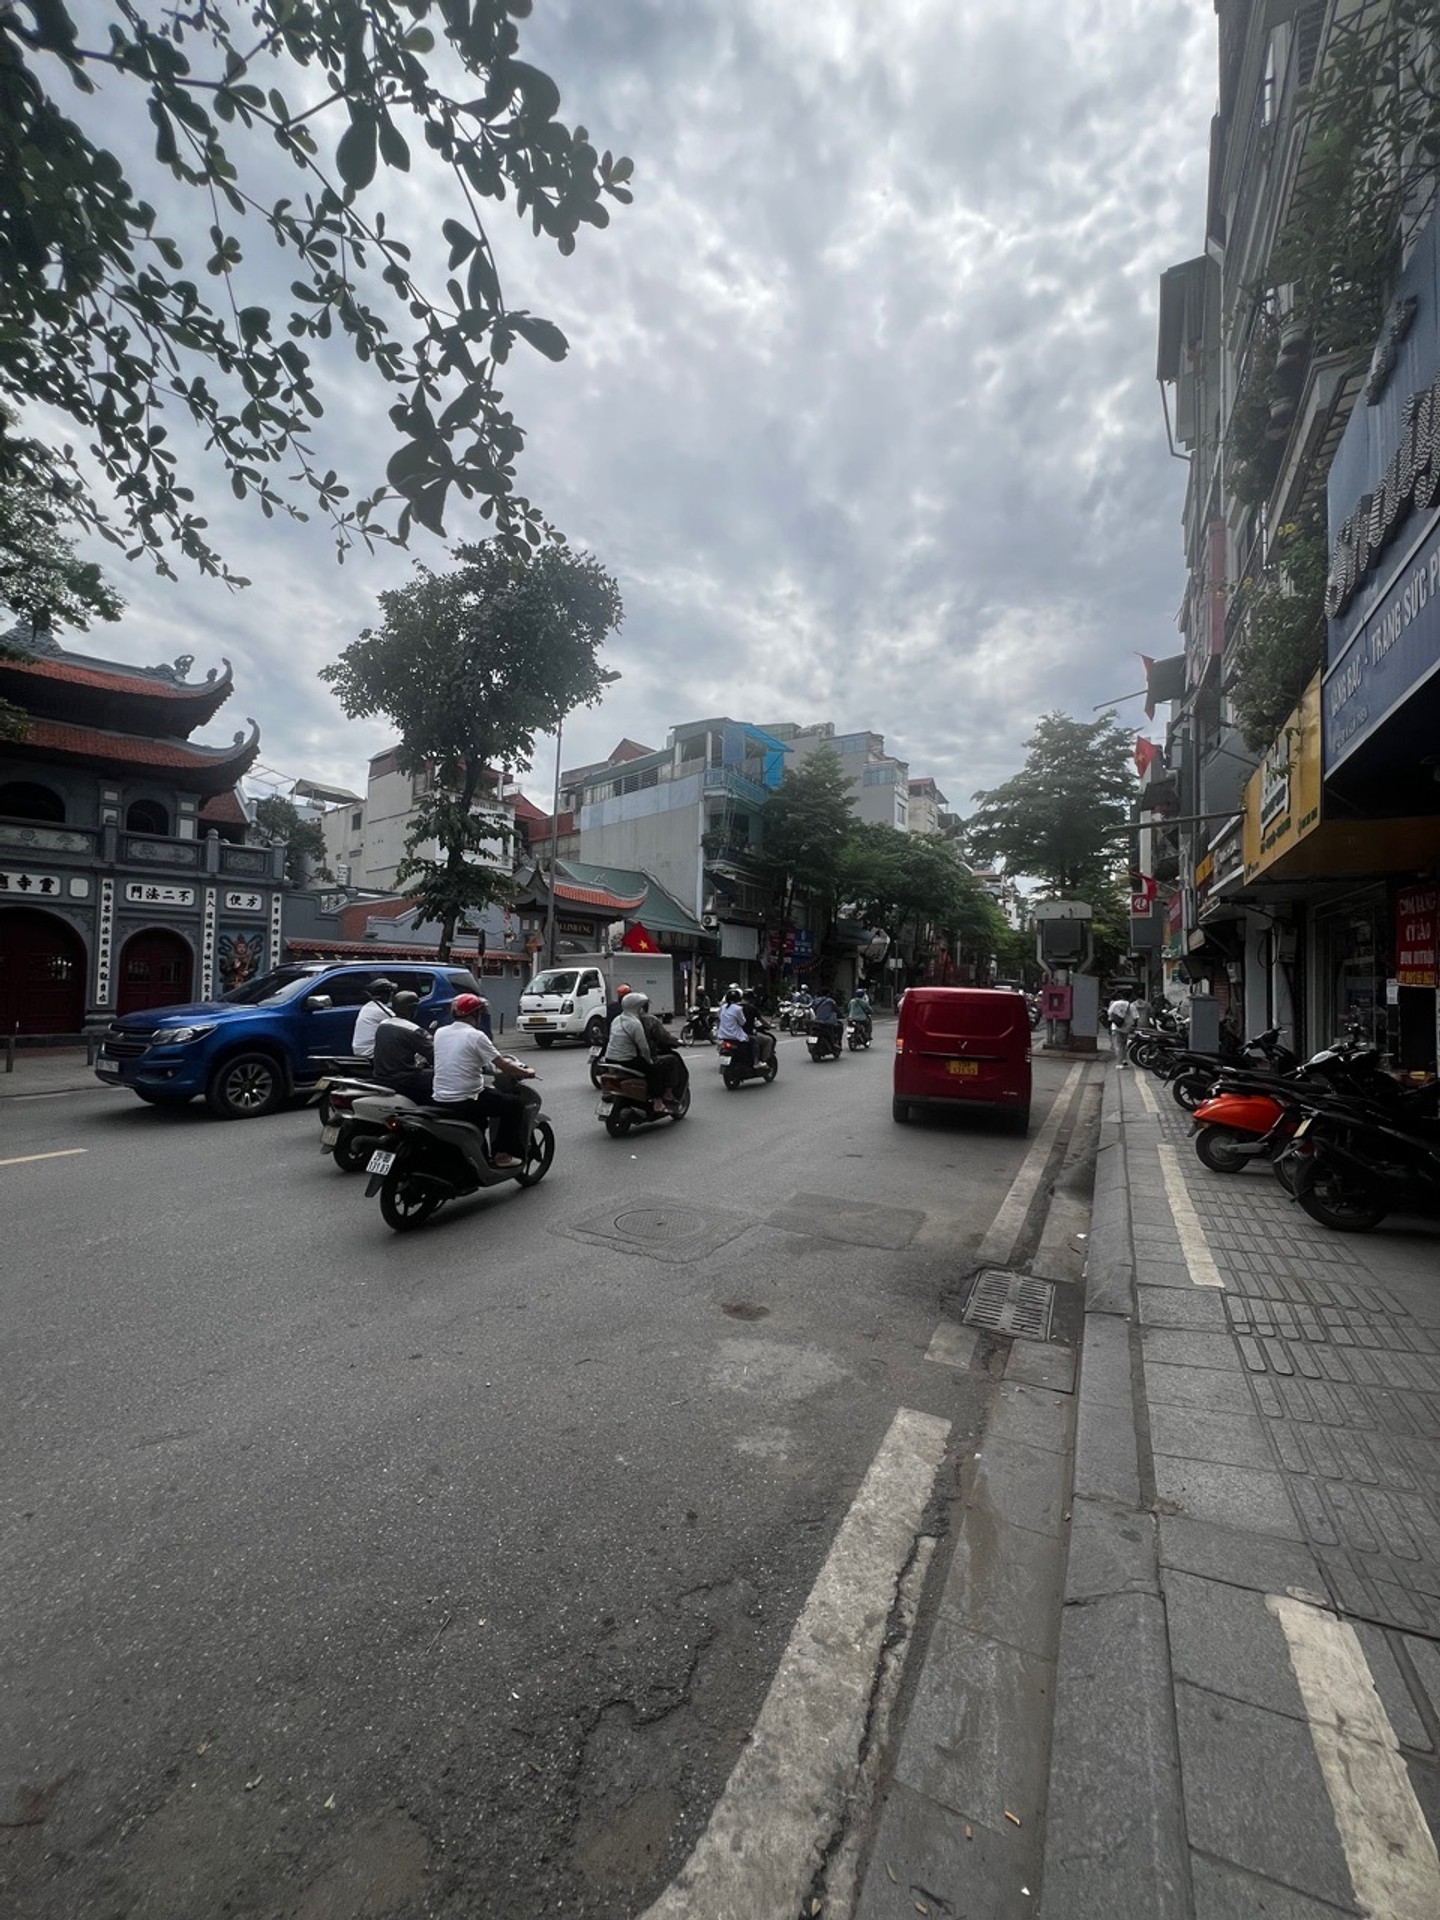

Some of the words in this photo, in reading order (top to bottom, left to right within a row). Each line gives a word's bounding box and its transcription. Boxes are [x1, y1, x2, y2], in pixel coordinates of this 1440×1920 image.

[1371, 601, 1401, 666] TRANG
[1404, 567, 1427, 626] SỨC
[1430, 546, 1440, 597] P
